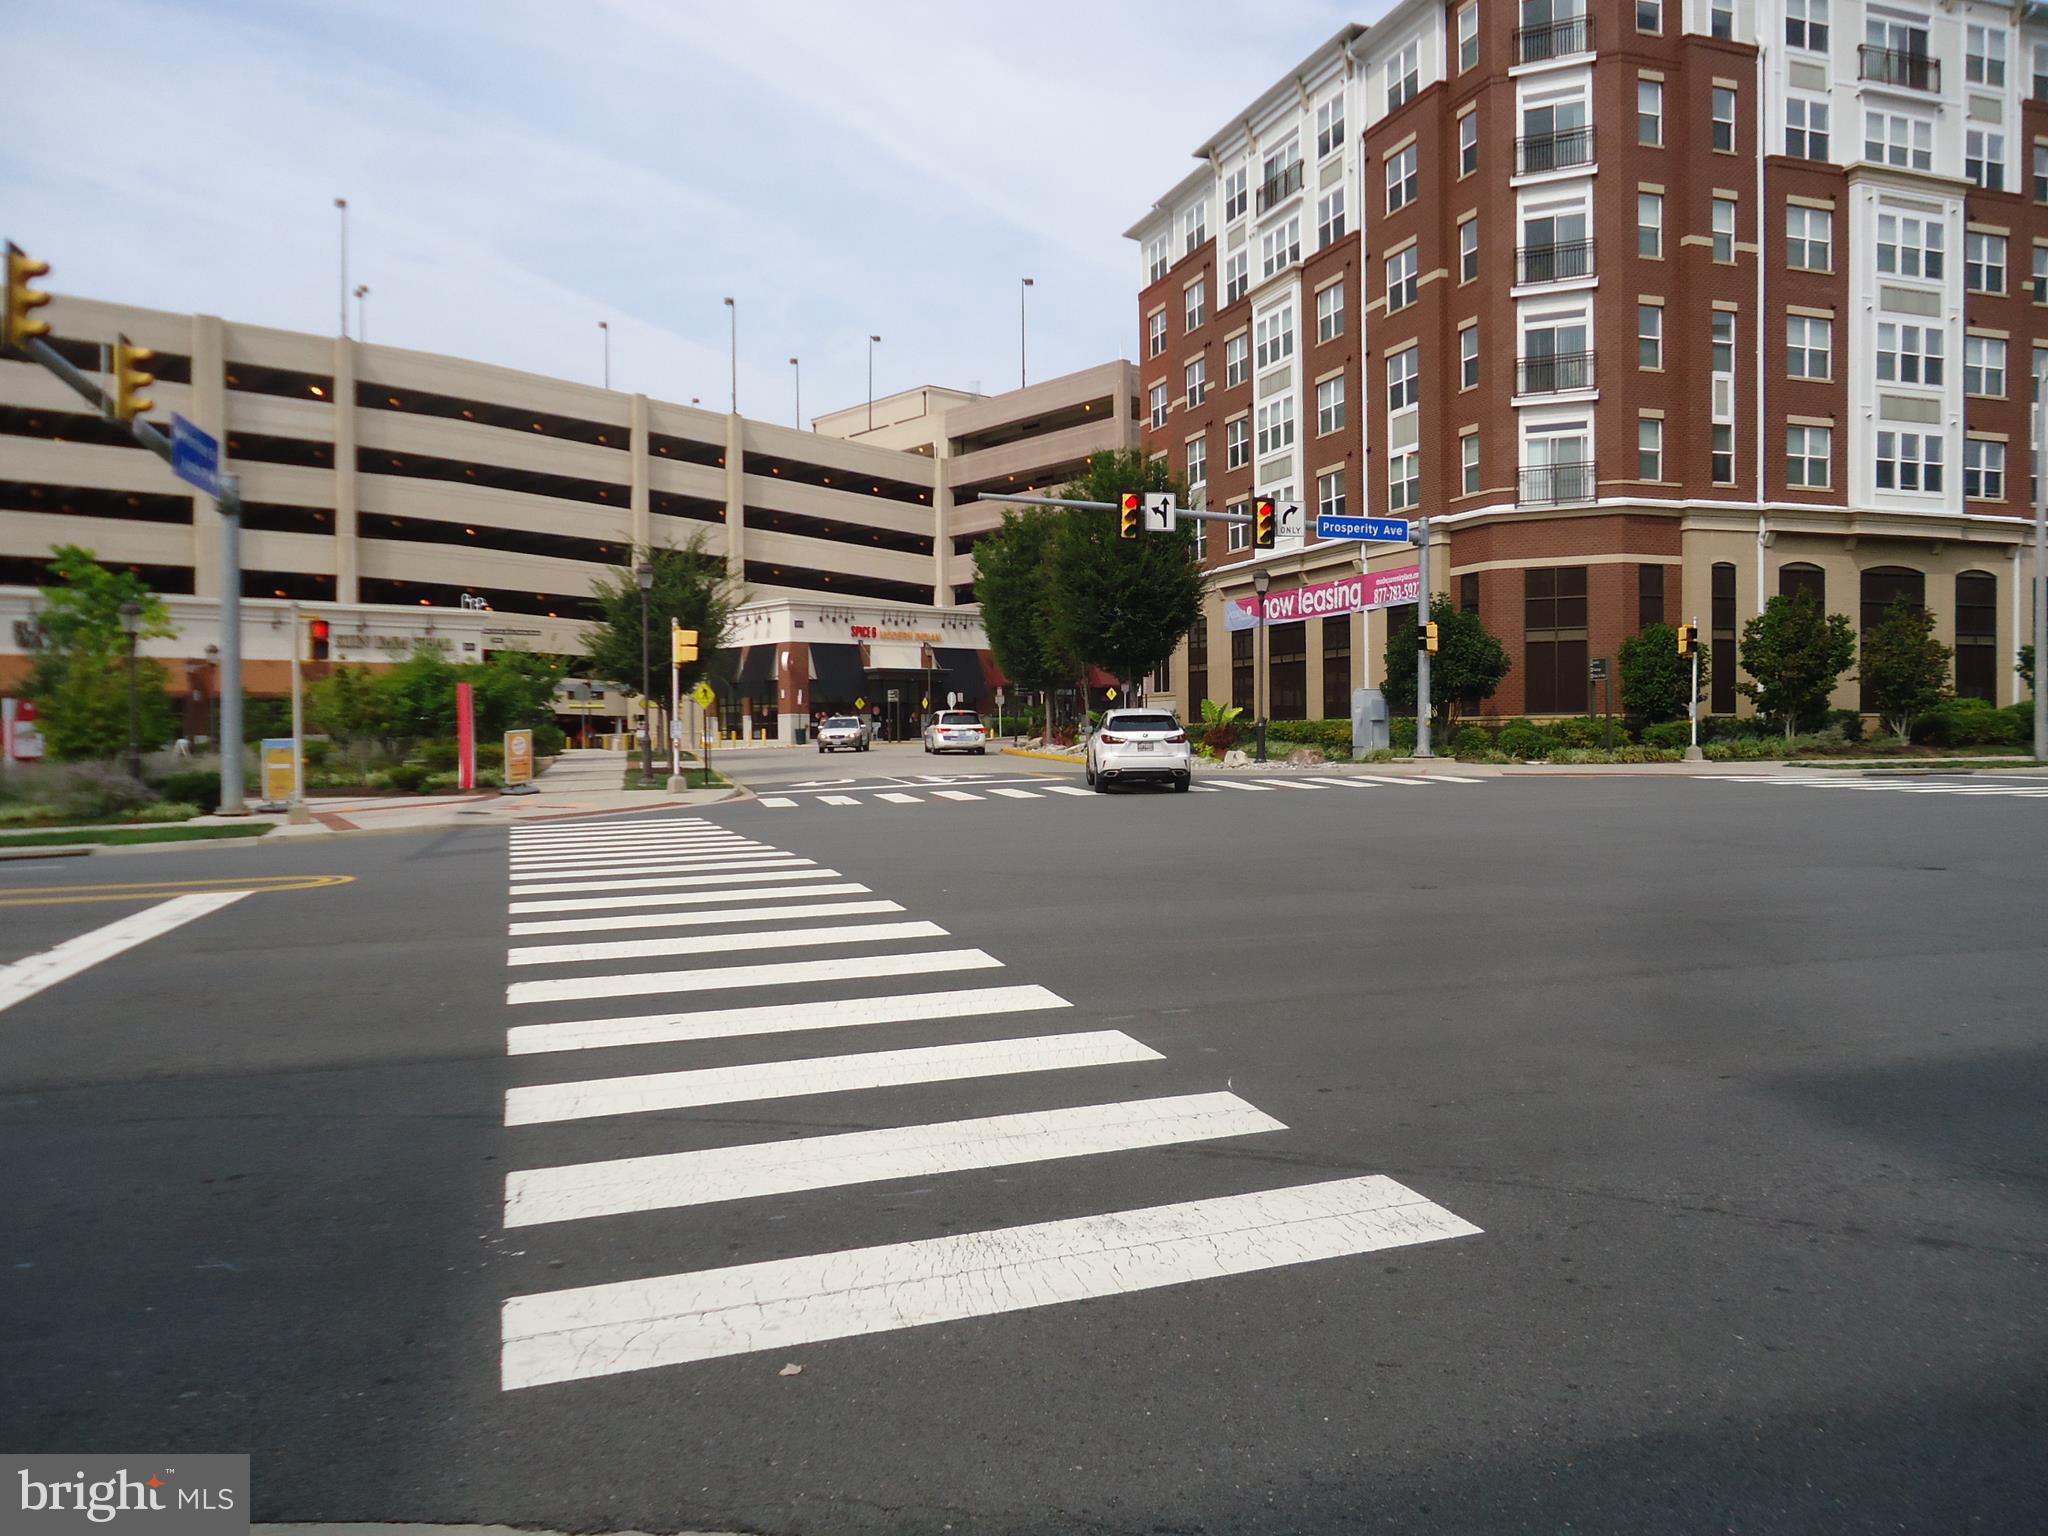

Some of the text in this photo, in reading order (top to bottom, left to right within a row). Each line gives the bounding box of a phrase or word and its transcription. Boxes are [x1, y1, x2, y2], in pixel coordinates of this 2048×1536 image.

[1322, 521, 1403, 537] Prosperity Ave
[1263, 580, 1361, 619] now leasing
[850, 625, 870, 639] SPICE
